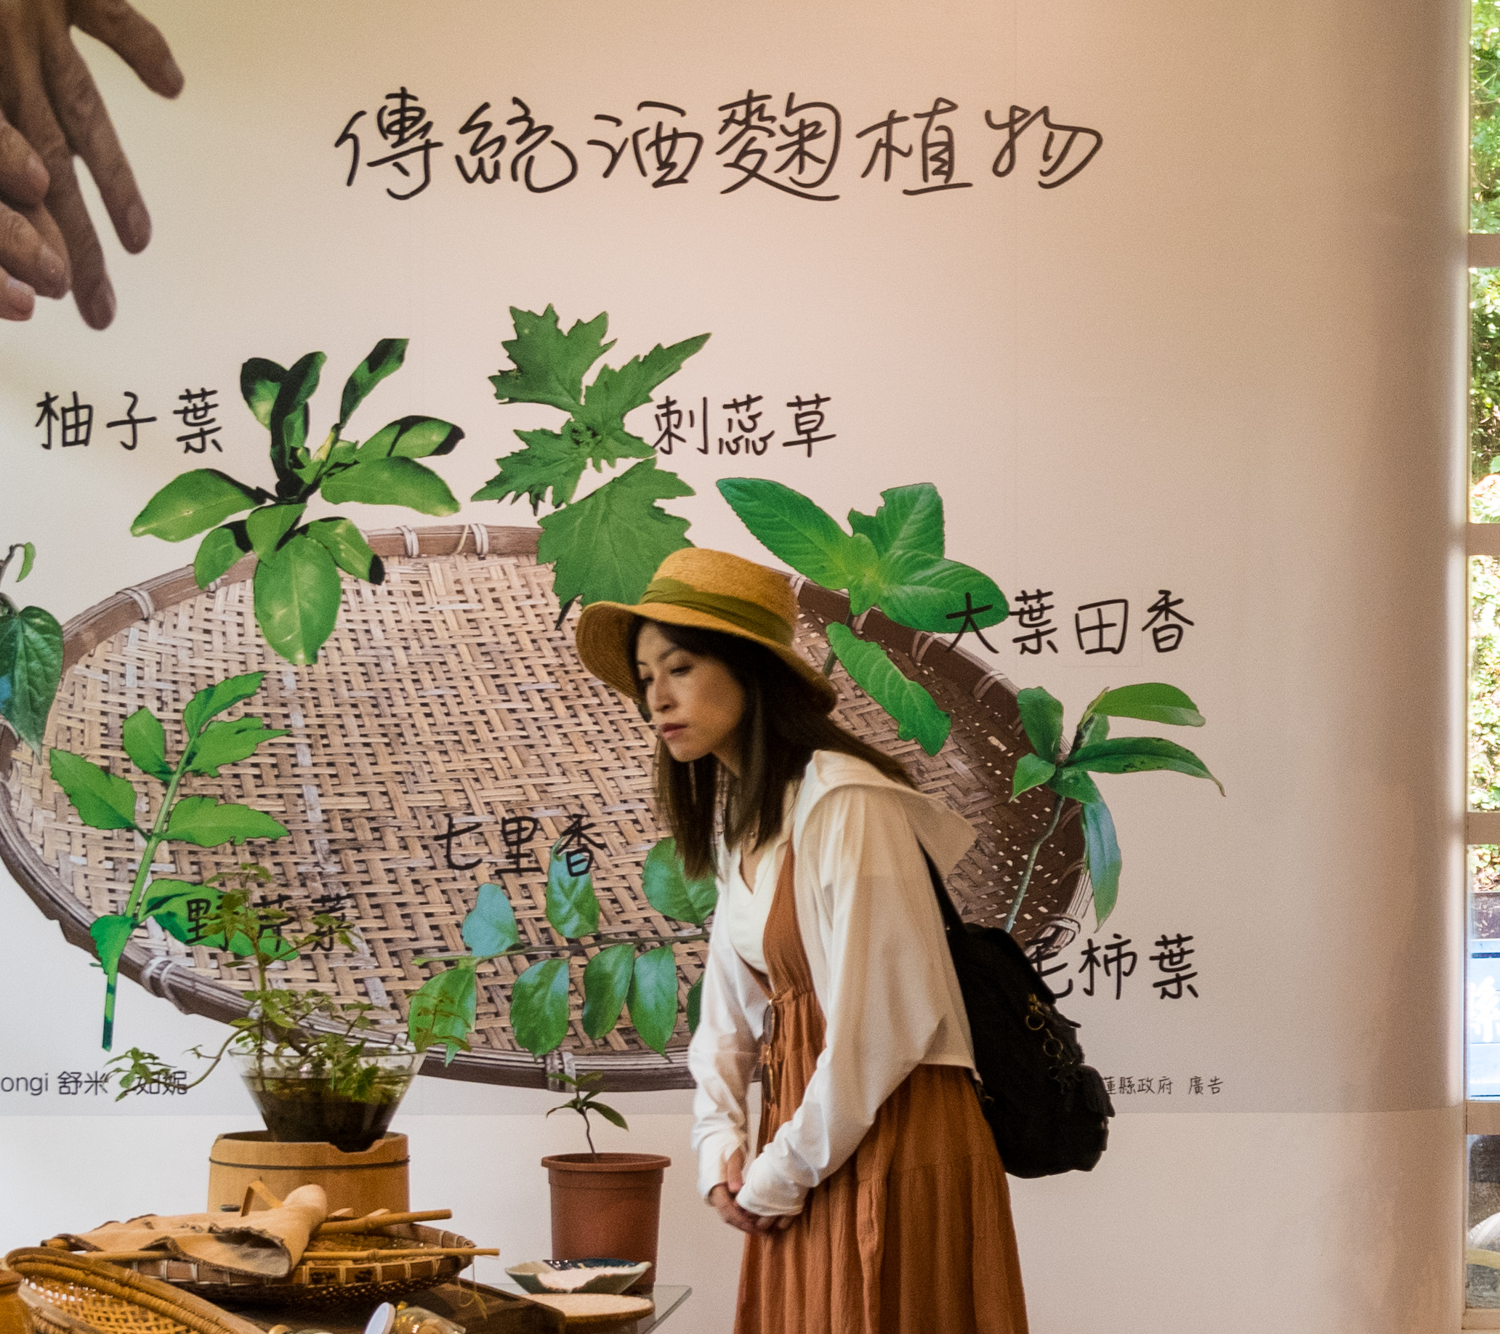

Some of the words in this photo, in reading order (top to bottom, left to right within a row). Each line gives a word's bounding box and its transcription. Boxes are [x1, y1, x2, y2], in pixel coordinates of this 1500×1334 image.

[334, 88, 1104, 203] 傳統酒麴植物
[35, 389, 224, 454] 柚子葉
[653, 394, 840, 457] 刺蕊草
[945, 589, 1195, 655] 大葉田香
[433, 813, 600, 877] 七里香
[1025, 933, 1199, 1000] 毛柿葉
[1188, 1075, 1224, 1095] 廣告
